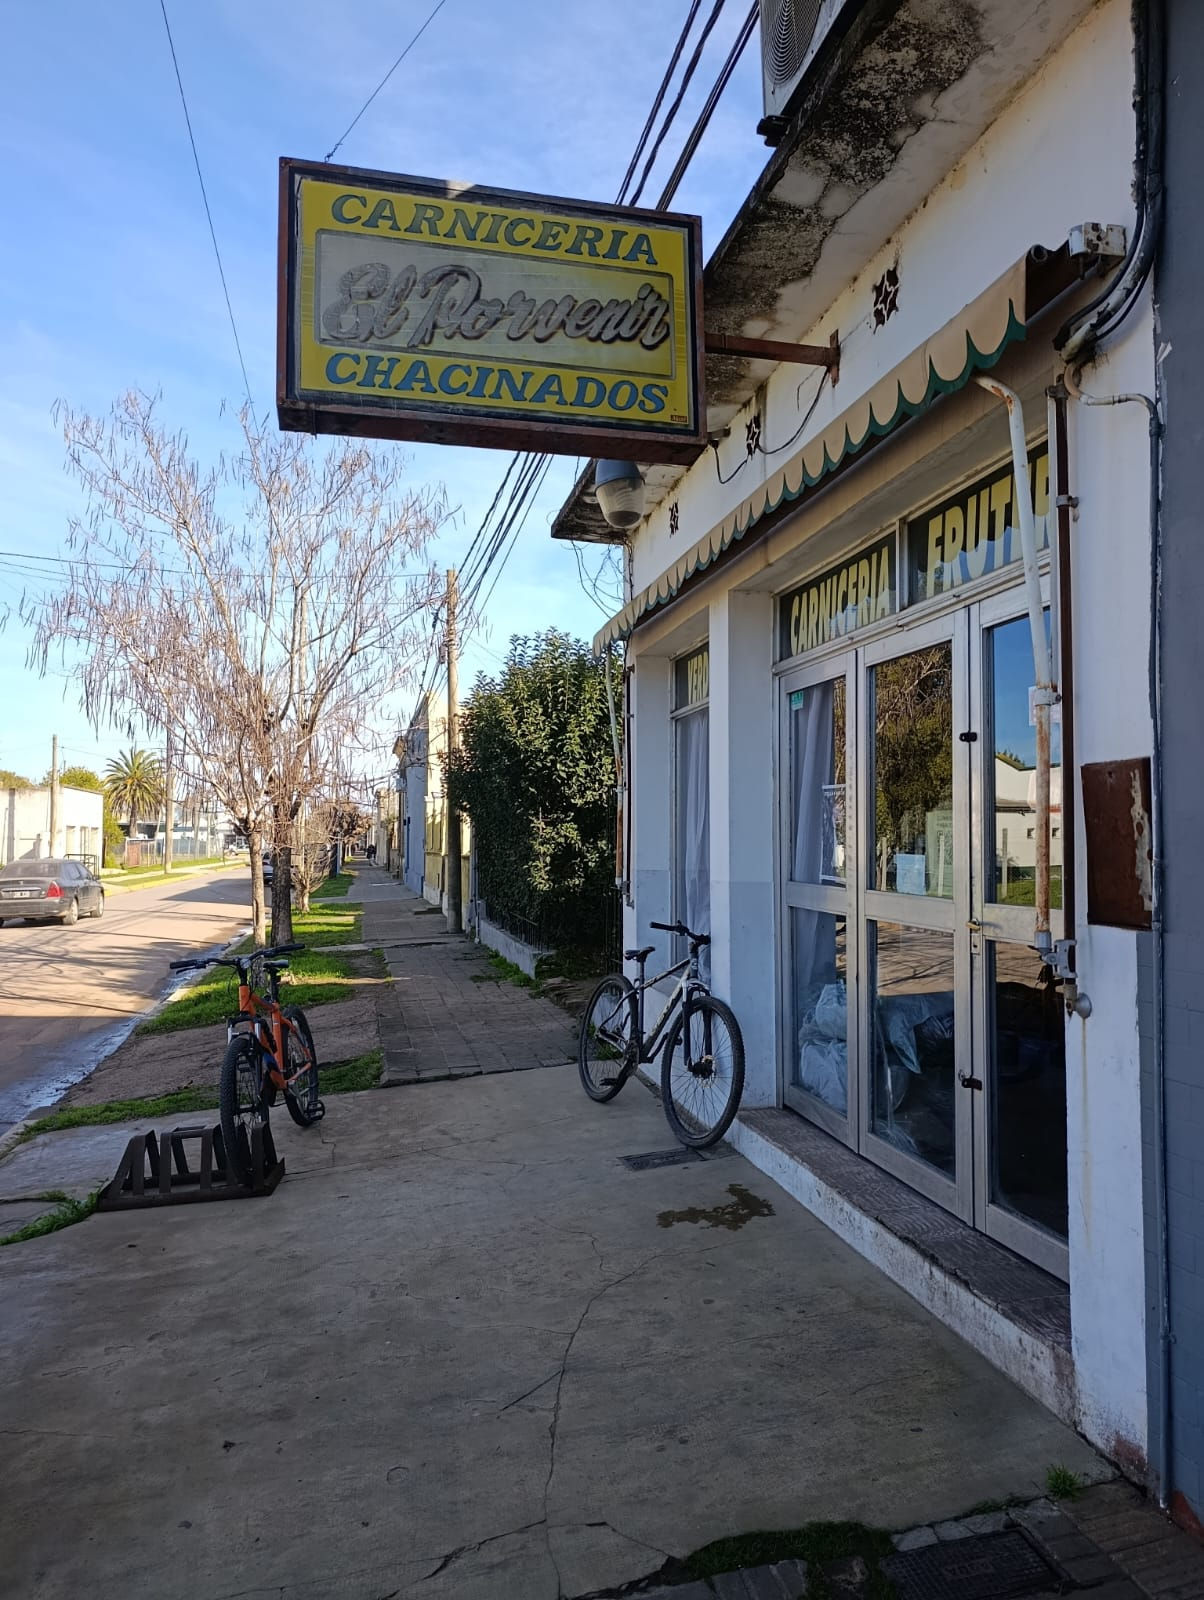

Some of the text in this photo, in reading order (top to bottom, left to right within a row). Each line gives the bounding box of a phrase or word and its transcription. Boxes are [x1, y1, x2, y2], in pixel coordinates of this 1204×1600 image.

[331, 194, 658, 265] CARNICERIA
[323, 262, 671, 350] El Porvenir
[325, 353, 669, 413] CHACINADOS
[790, 546, 890, 656] CARNICERIA
